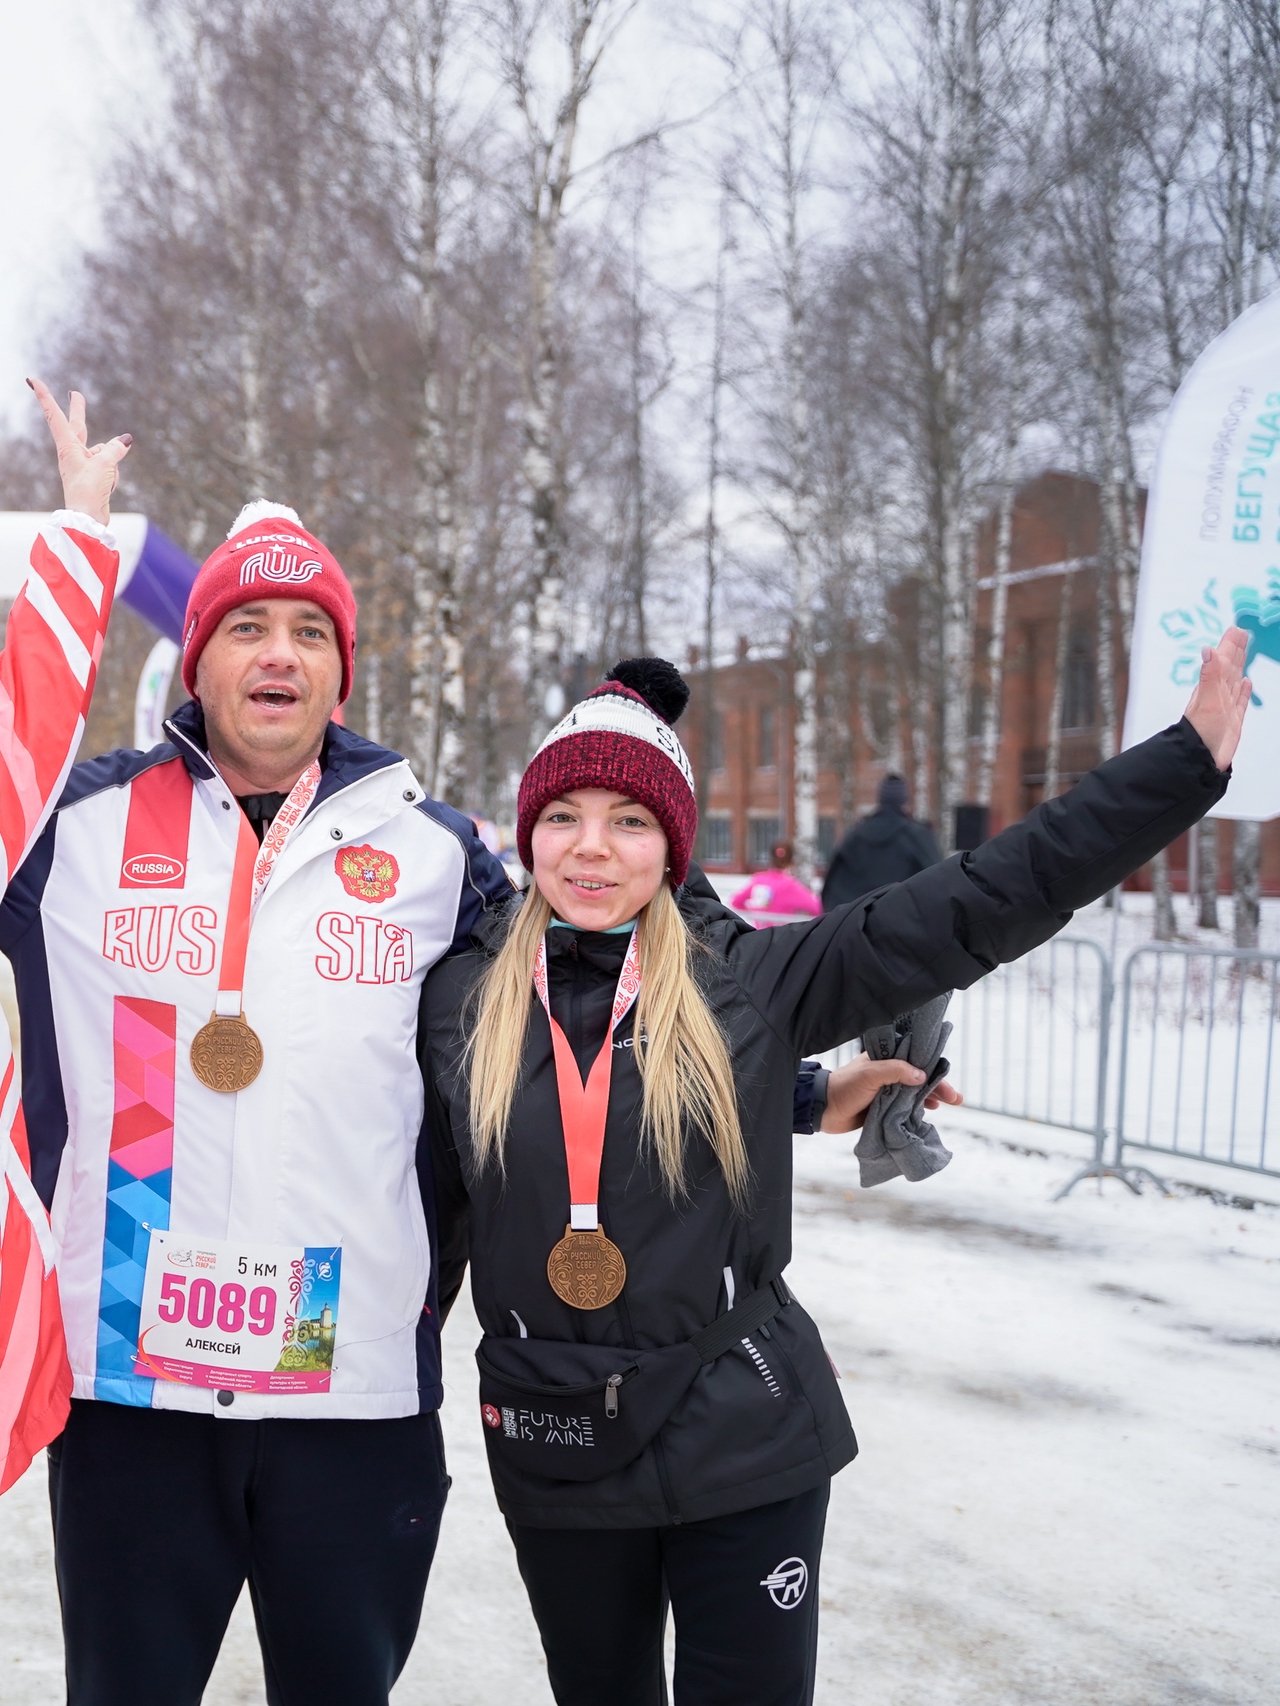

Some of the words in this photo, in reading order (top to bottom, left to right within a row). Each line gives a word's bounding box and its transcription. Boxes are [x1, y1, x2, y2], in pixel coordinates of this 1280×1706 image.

[236, 534, 313, 550] LUKOIL
[278, 804, 293, 822] 03.11
[286, 808, 302, 827] 2024
[131, 863, 175, 874] RUSSIA
[103, 905, 218, 976] RUS
[315, 911, 415, 985] SIA
[616, 996, 631, 1019] 2024
[238, 1256, 248, 1275] 5
[254, 1263, 277, 1277] КМ
[158, 1272, 277, 1336] 5089
[185, 1337, 241, 1355] АЛЕКСЕЙ
[520, 1410, 593, 1430] FUTURE
[520, 1425, 534, 1441] IS
[545, 1429, 595, 1446] MINE
